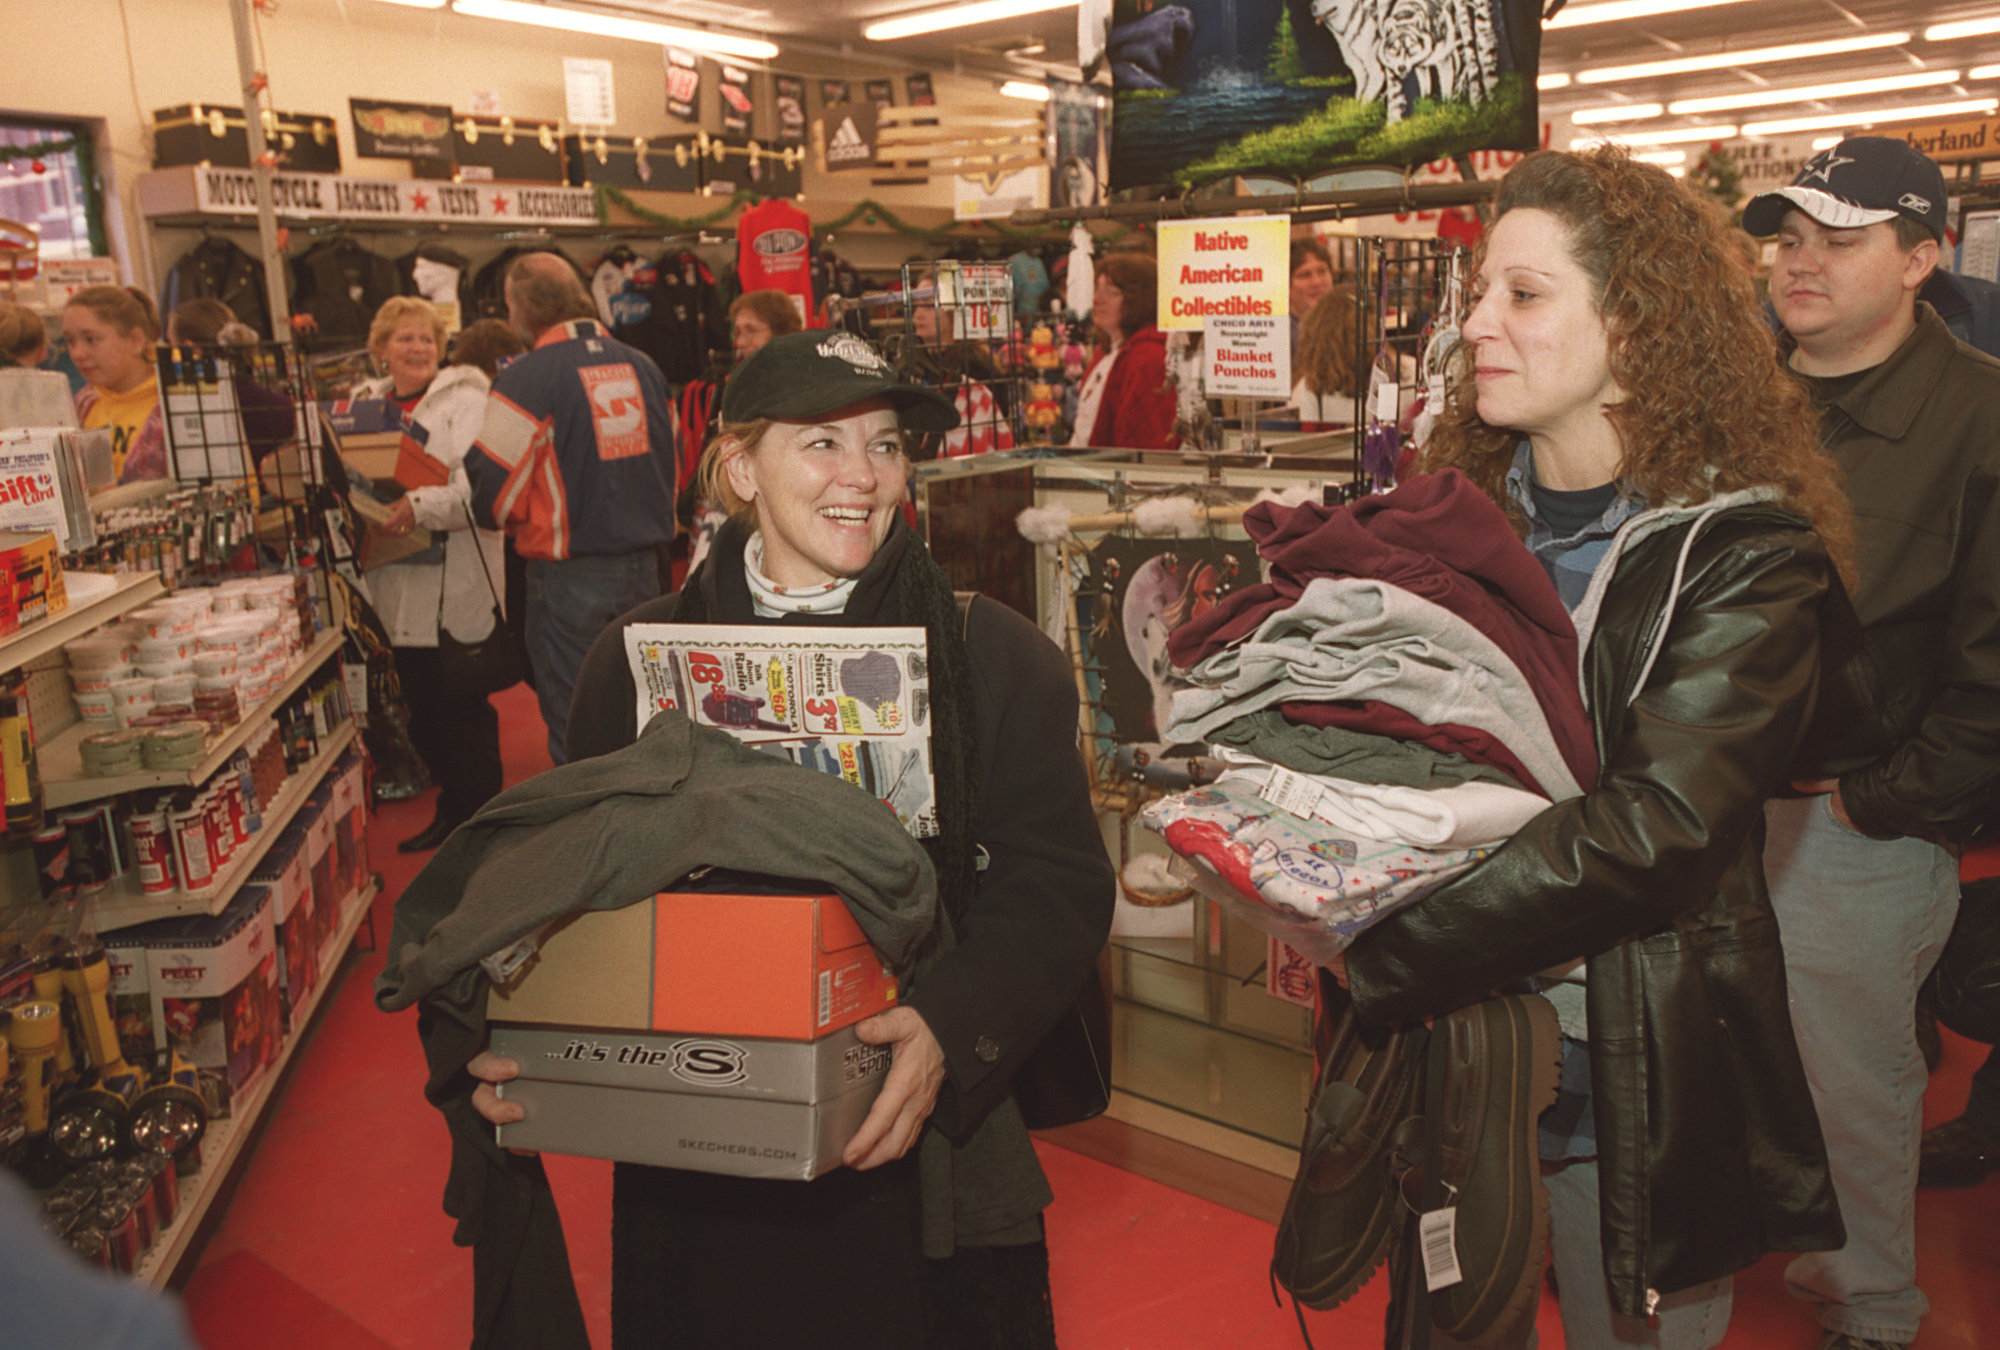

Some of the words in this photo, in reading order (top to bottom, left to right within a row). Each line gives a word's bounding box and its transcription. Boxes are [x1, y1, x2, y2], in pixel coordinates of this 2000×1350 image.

[1907, 123, 1986, 153] berland
[207, 173, 322, 208] MOTOCYCLE
[336, 182, 399, 211] JACKETS
[438, 187, 479, 215] VESTS
[517, 190, 598, 218] ACCESSORIES
[1194, 230, 1248, 251] Native
[1180, 263, 1262, 284] American
[1171, 296, 1272, 316] Collectibles
[1213, 320, 1246, 328] CHICO
[1249, 320, 1275, 328] ARTS
[1216, 348, 1273, 362] Blanket
[1214, 364, 1276, 378] Ponchos
[23, 485, 55, 506] Card
[735, 652, 747, 691] Radio
[746, 660, 755, 685] About
[814, 653, 825, 696] Shirts
[826, 658, 835, 692] Flannel
[773, 691, 786, 713] $60
[786, 665, 798, 728] MOTOROLA
[847, 700, 861, 729] GREAT
[841, 744, 855, 769] $28
[110, 964, 133, 977] ET
[160, 966, 207, 980] PEET
[617, 1043, 667, 1066] the
[857, 1050, 893, 1080] SPOR
[678, 1138, 797, 1161] SKECHERS.COM
